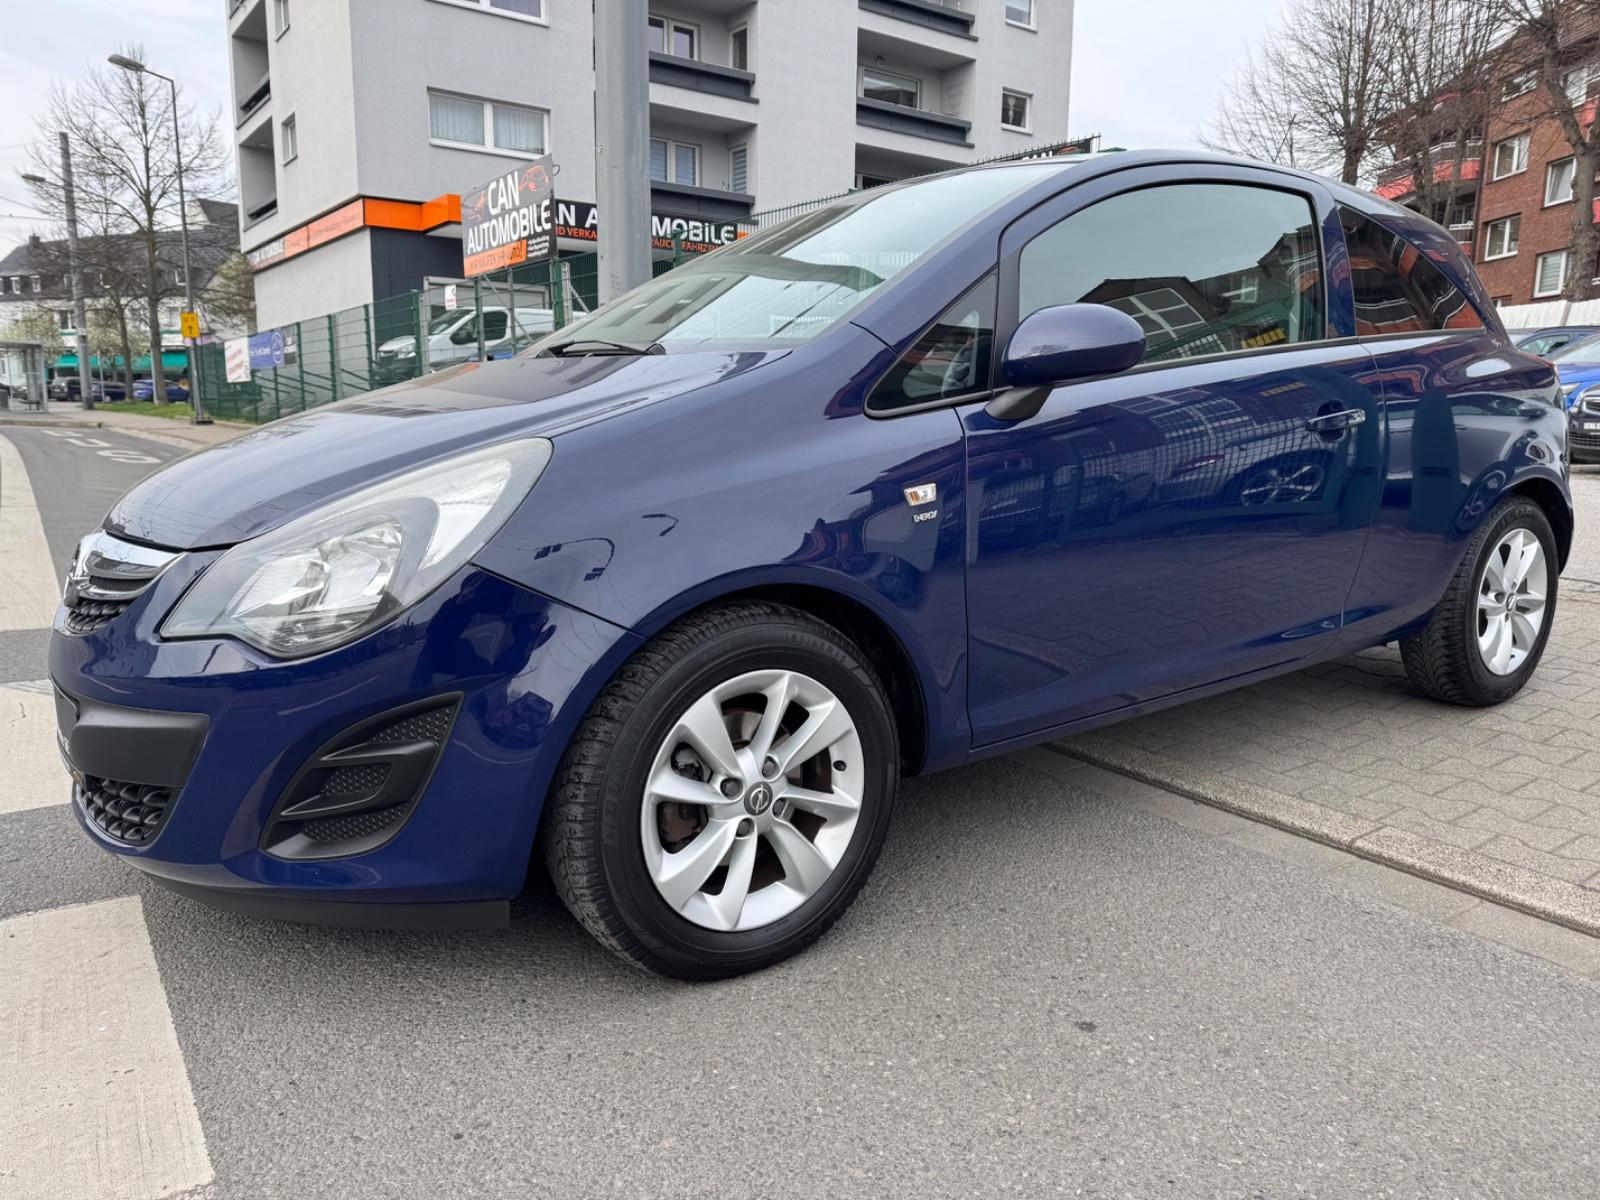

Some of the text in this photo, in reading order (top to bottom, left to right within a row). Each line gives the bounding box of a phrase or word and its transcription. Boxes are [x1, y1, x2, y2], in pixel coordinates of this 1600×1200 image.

[488, 171, 520, 215] CAN
[467, 199, 552, 255] AUTOMOBILE
[567, 228, 598, 240] VERKA
